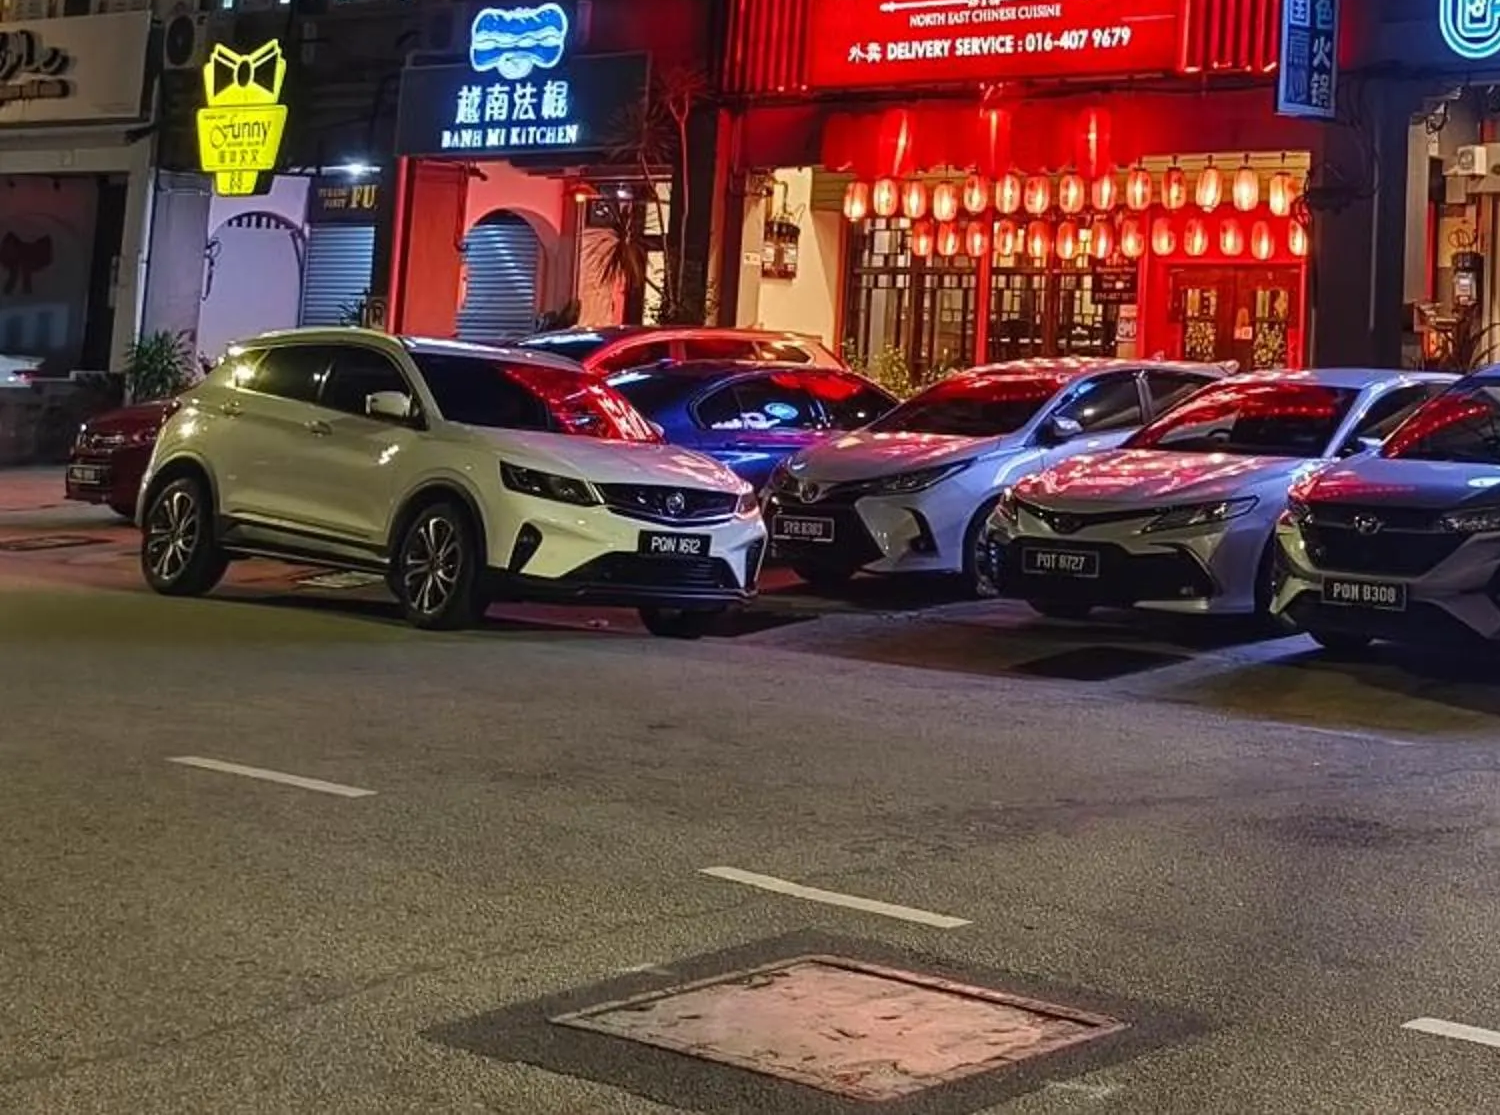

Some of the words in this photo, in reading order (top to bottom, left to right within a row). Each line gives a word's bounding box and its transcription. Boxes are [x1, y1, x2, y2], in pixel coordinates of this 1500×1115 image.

[909, 12, 945, 28] NORTH
[947, 10, 970, 26] EAST
[971, 7, 1016, 23] CHINESE
[1018, 3, 1062, 20] CUISINE
[886, 38, 951, 60] DELIVERY
[955, 34, 1014, 56] SERVICE
[441, 129, 483, 148] BANH
[486, 128, 507, 146] MI
[509, 125, 579, 145] KITCHEN
